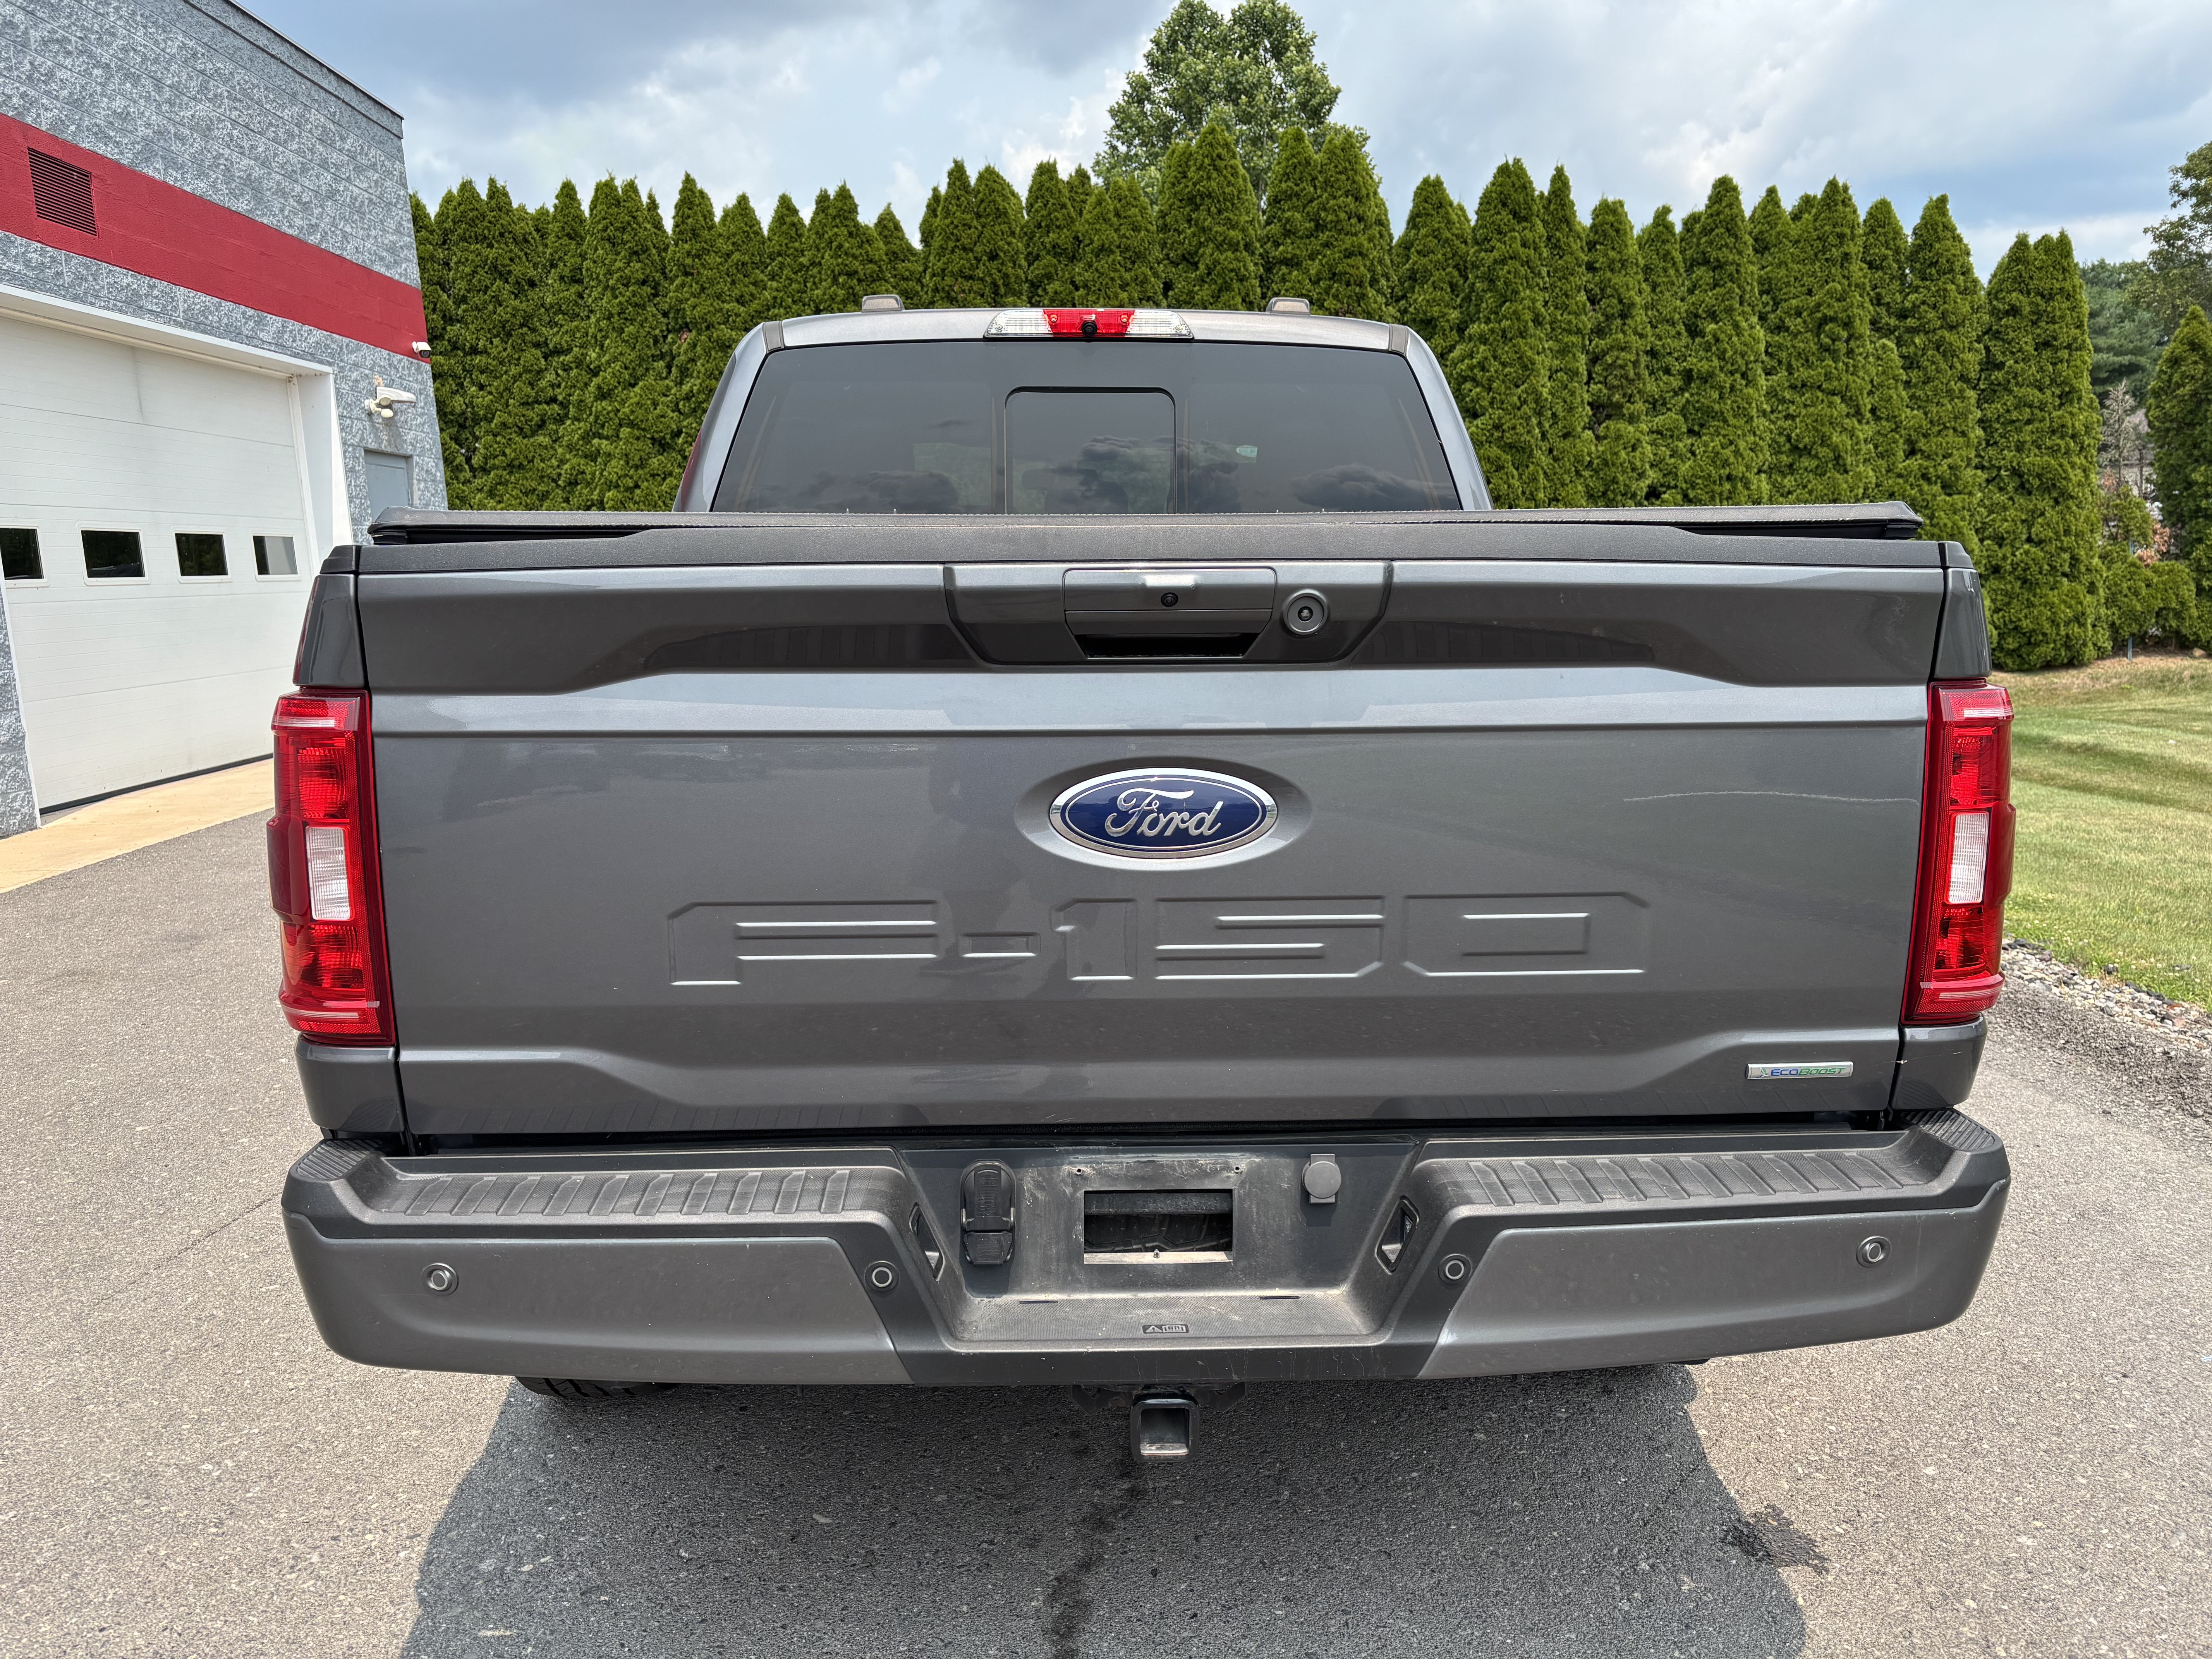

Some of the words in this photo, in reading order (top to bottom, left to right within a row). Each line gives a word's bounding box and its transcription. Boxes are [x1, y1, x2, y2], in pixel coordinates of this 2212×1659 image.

[1104, 787, 1224, 837] Ford
[667, 891, 1650, 985] F-150
[1771, 1067, 1846, 1076] ECOBOOST
